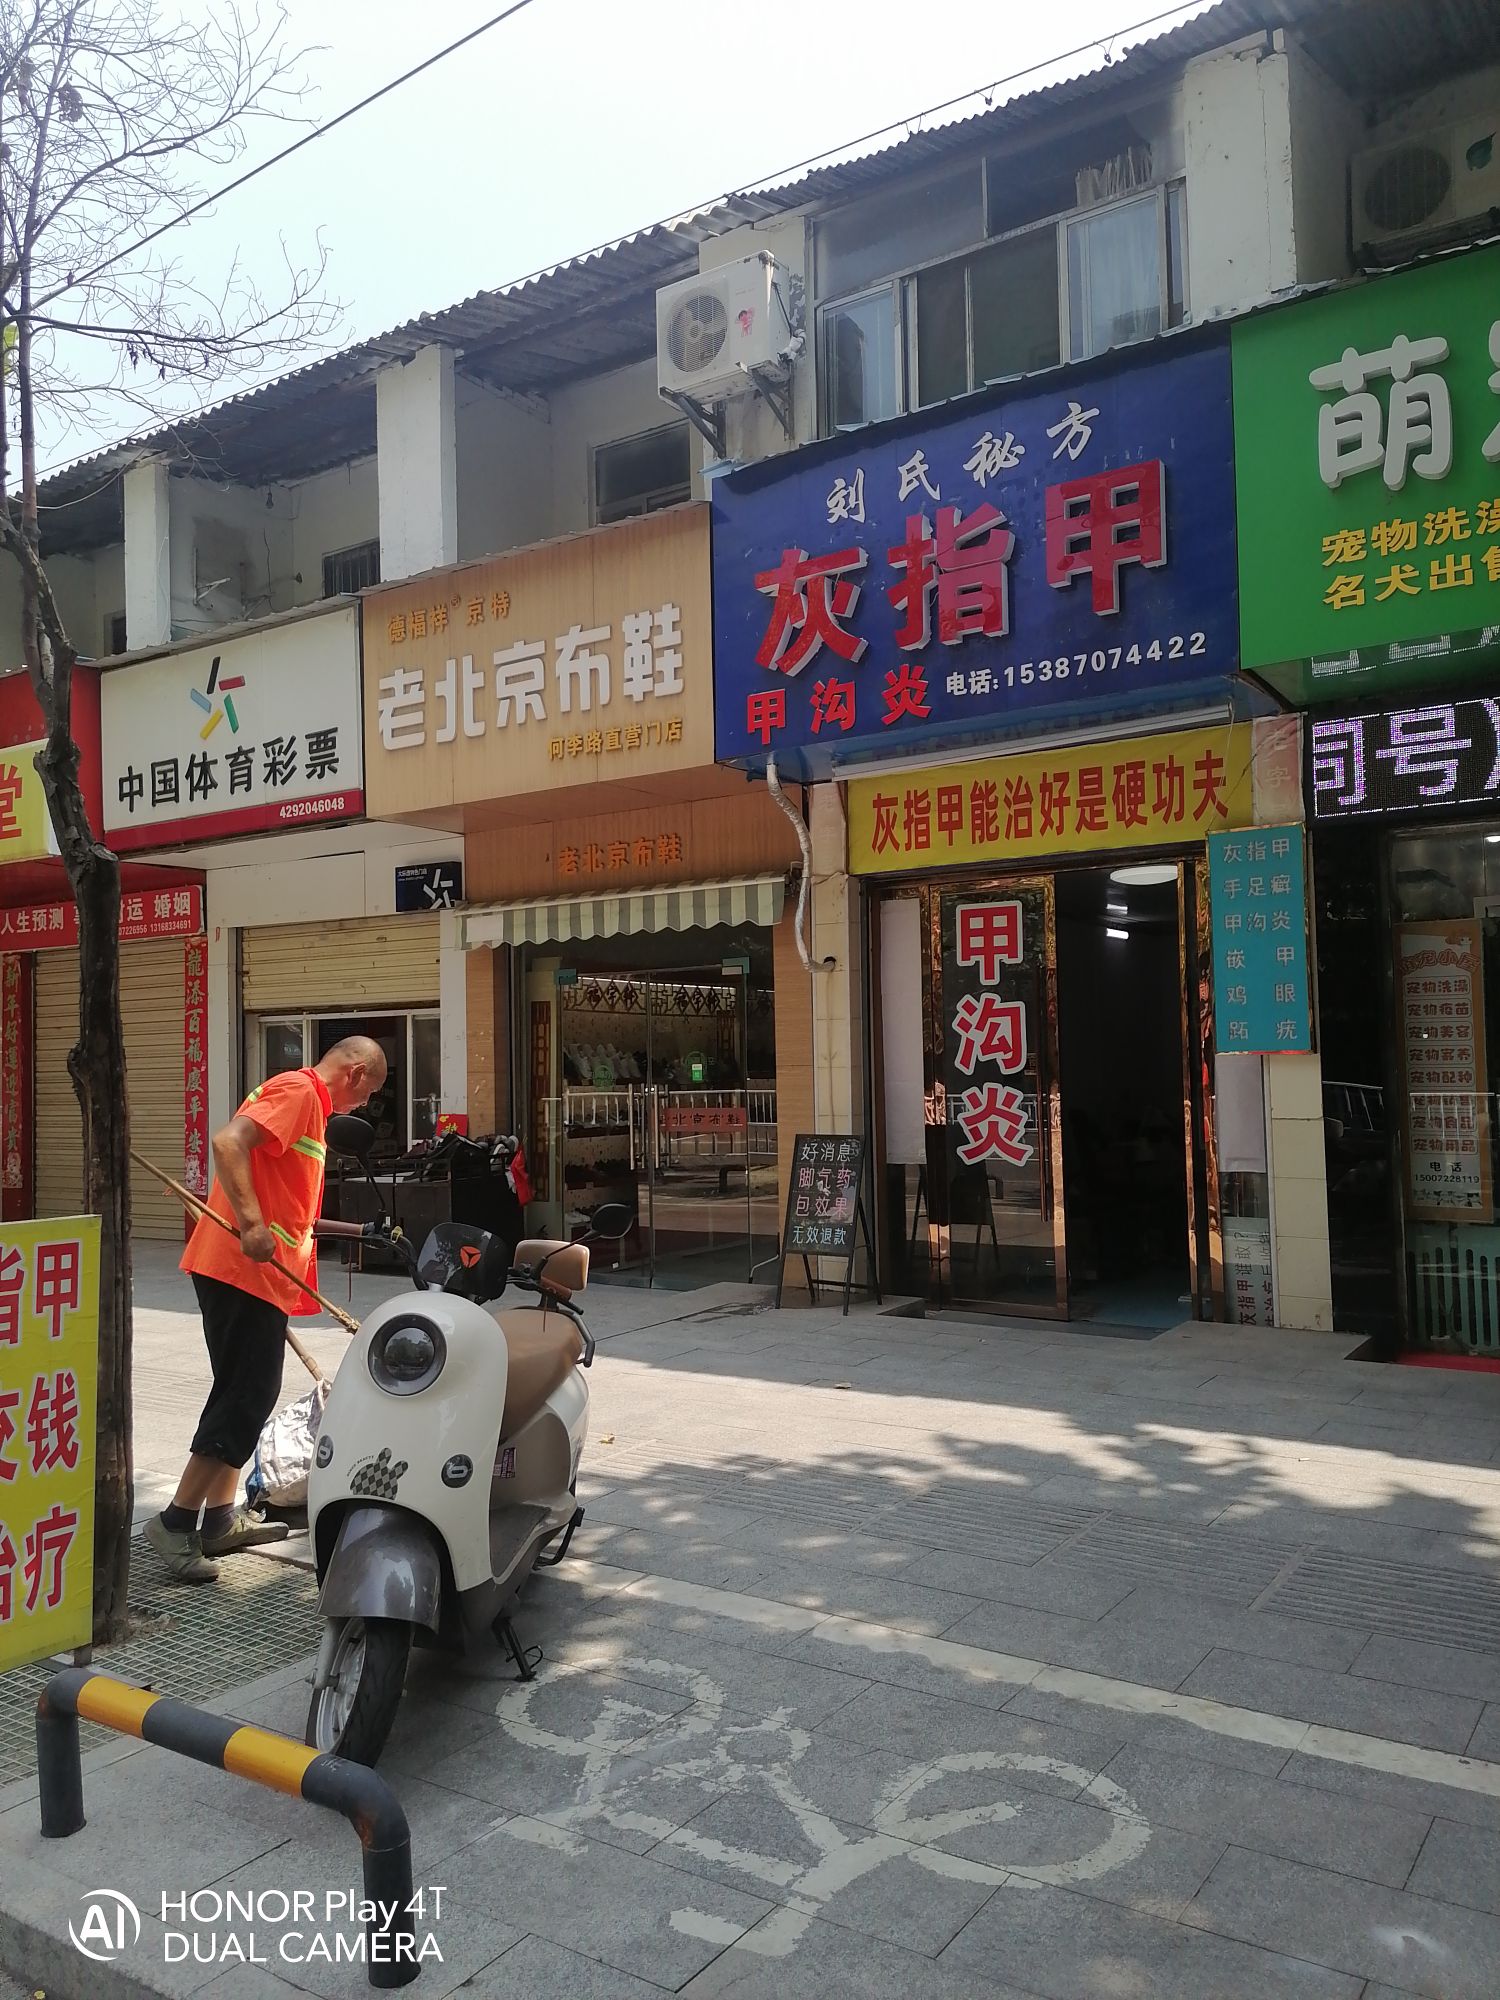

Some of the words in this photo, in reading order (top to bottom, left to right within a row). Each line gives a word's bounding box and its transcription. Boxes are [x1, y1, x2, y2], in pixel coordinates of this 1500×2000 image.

[827, 402, 1100, 524] 刘氏秘方
[754, 459, 1167, 677] 灰指甲
[378, 603, 685, 751] 老北京布鞋
[746, 664, 932, 745] 甲沟炎
[118, 727, 339, 812] 中国体育彩票
[279, 797, 345, 819] 4292046048
[871, 750, 1229, 856] 灰指甲能治好是硬功夫
[559, 832, 683, 872] 老北京布鞋
[1223, 838, 1290, 863] 灰指甲
[1, 905, 64, 935] 人生预测
[120, 898, 143, 924] 运
[154, 892, 191, 918] 婚姻
[1224, 910, 1292, 934] 甲沟炎
[952, 901, 1033, 1167] 甲沟炎
[801, 1142, 851, 1162] 好消息
[798, 1166, 852, 1190] 脚气药
[796, 1195, 848, 1217] 包效果
[792, 1225, 847, 1245] 无效退款
